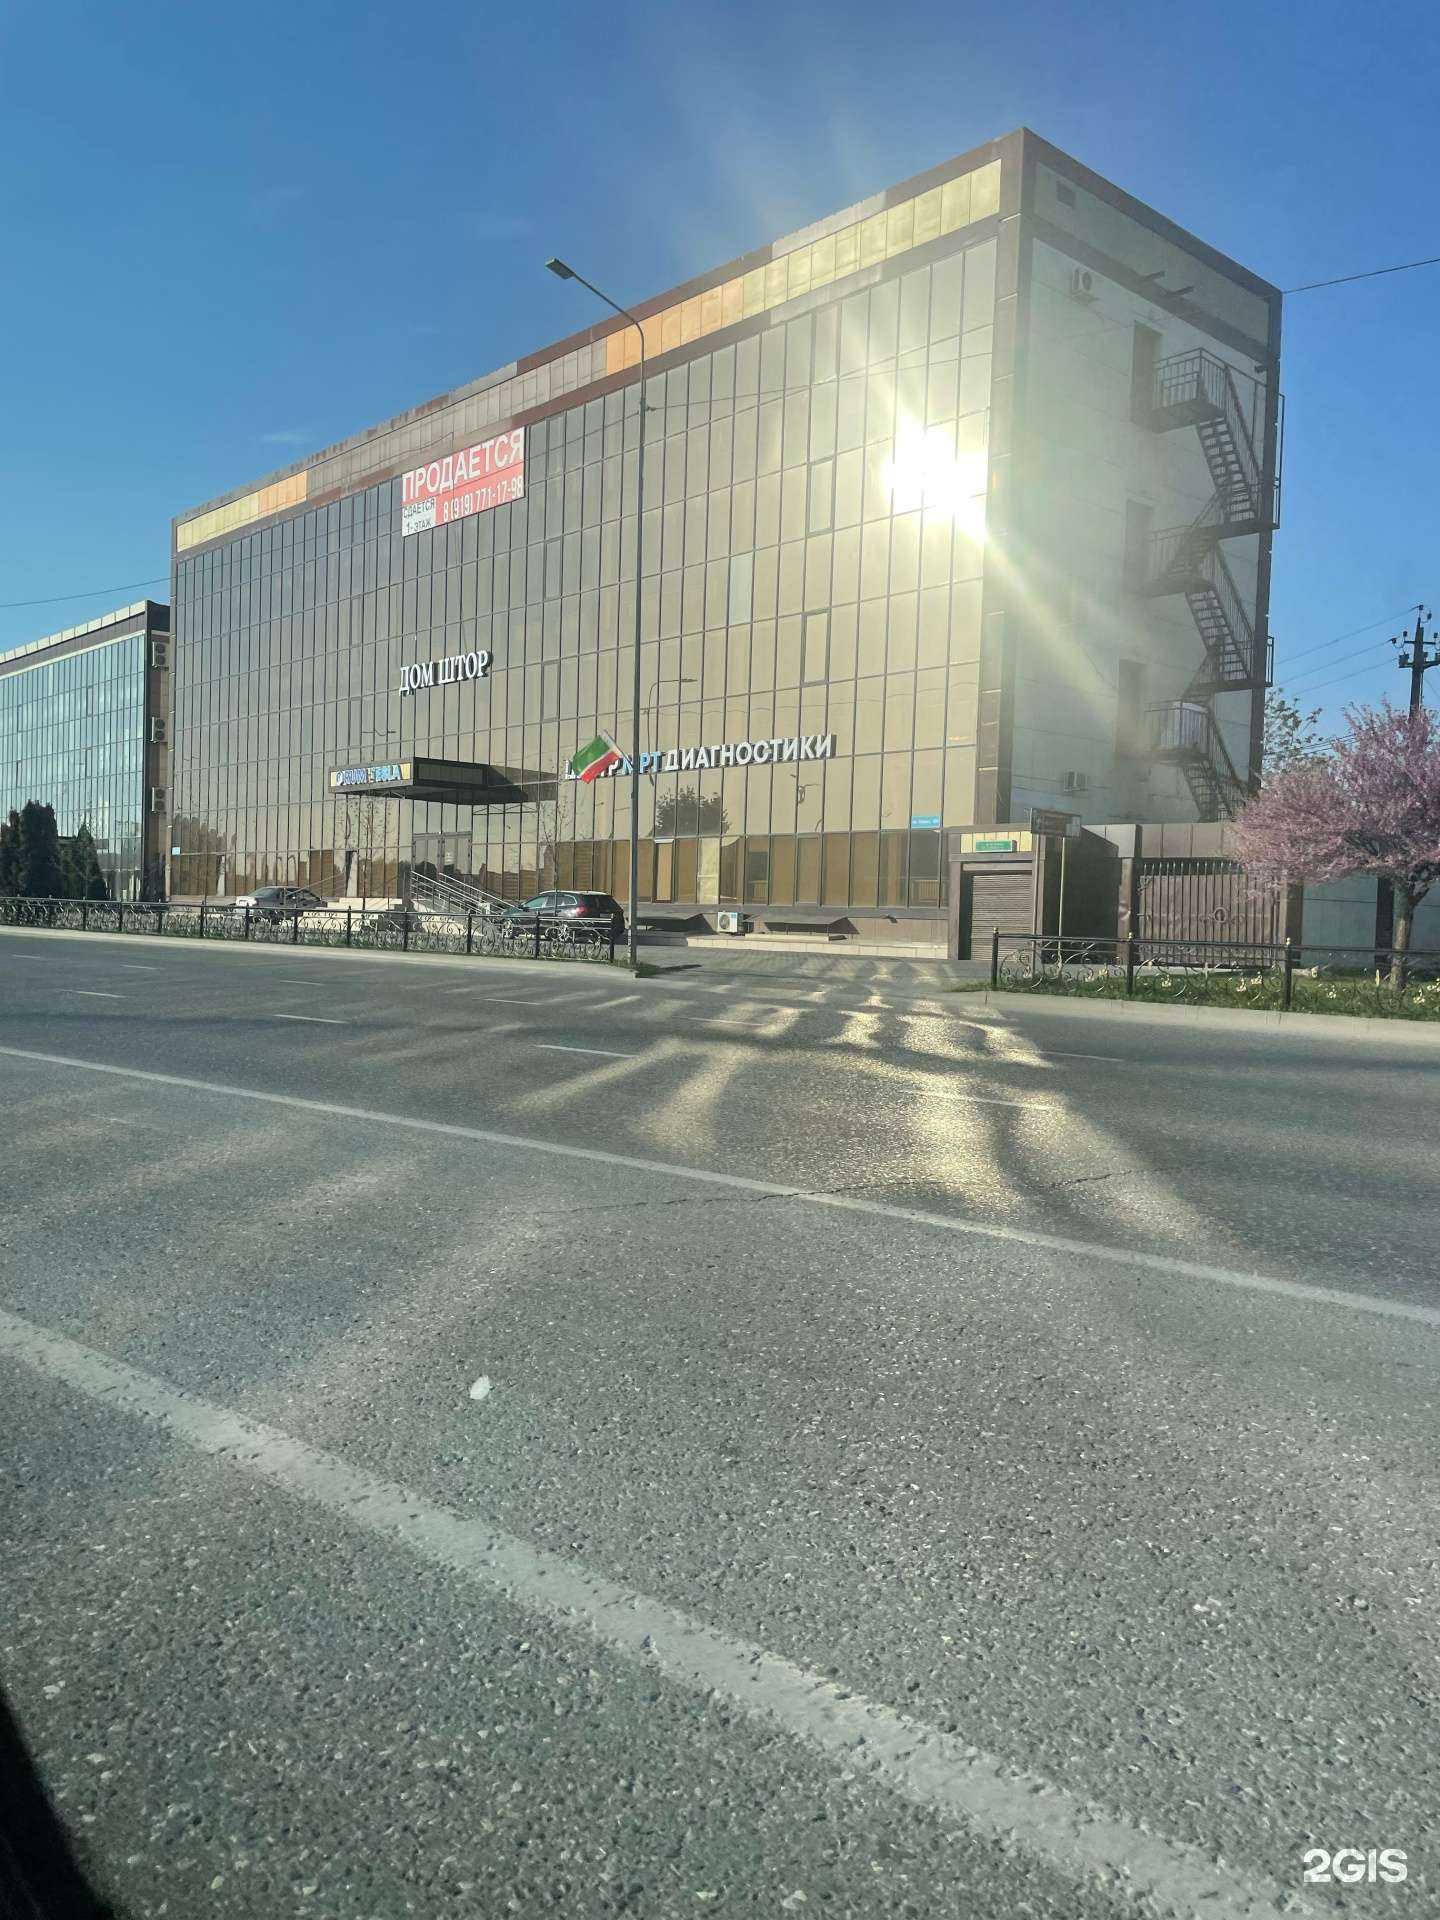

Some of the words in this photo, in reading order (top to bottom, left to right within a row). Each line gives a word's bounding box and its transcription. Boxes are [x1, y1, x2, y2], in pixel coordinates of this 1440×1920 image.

[402, 429, 525, 502] ПРОДАЕТСЯ
[399, 661, 434, 696] ДОМ
[438, 650, 489, 685] ШТОР
[664, 734, 832, 771] ДИАГНОСТИКИ
